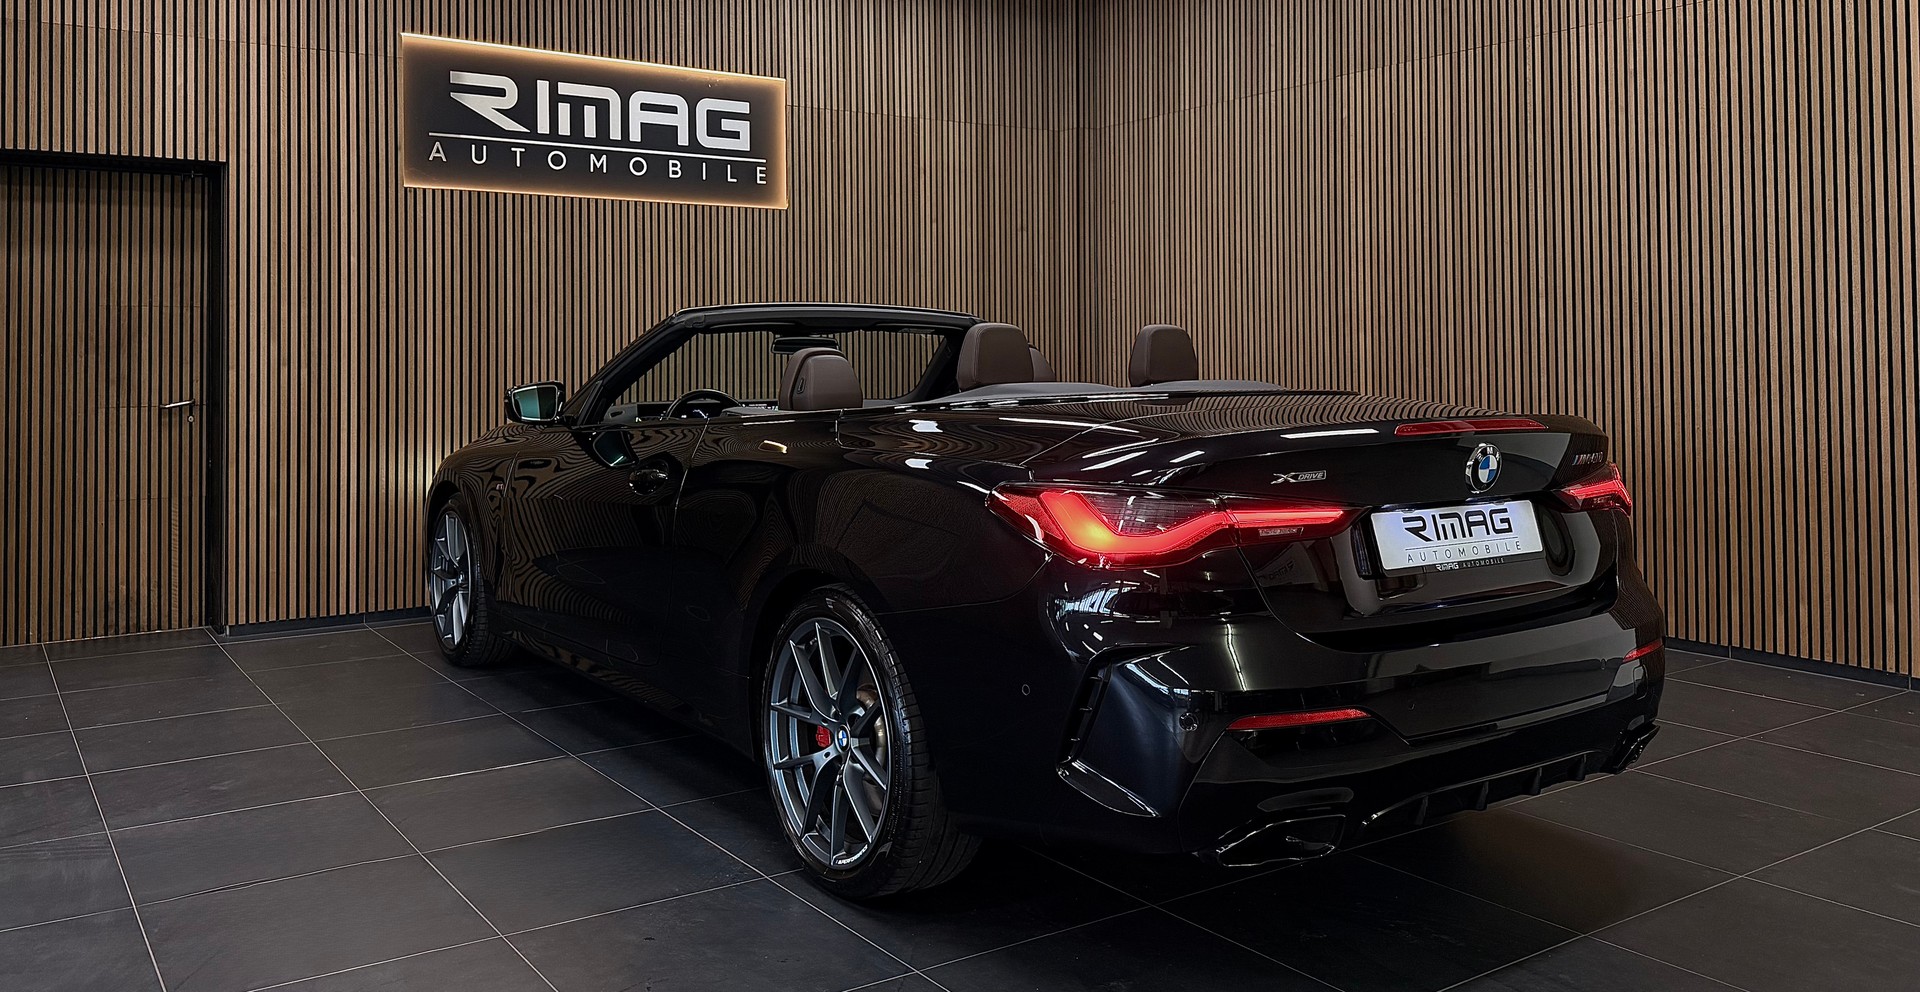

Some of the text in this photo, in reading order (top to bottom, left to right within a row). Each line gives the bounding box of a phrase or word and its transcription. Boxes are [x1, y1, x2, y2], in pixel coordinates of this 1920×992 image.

[449, 70, 751, 152] RIMAG
[428, 141, 768, 185] AUTOMOBILE
[1402, 507, 1513, 542] RIMAG
[1407, 540, 1521, 563] AUTOMOBILE
[1435, 557, 1504, 571] RIMAG AUTOMOBILE
